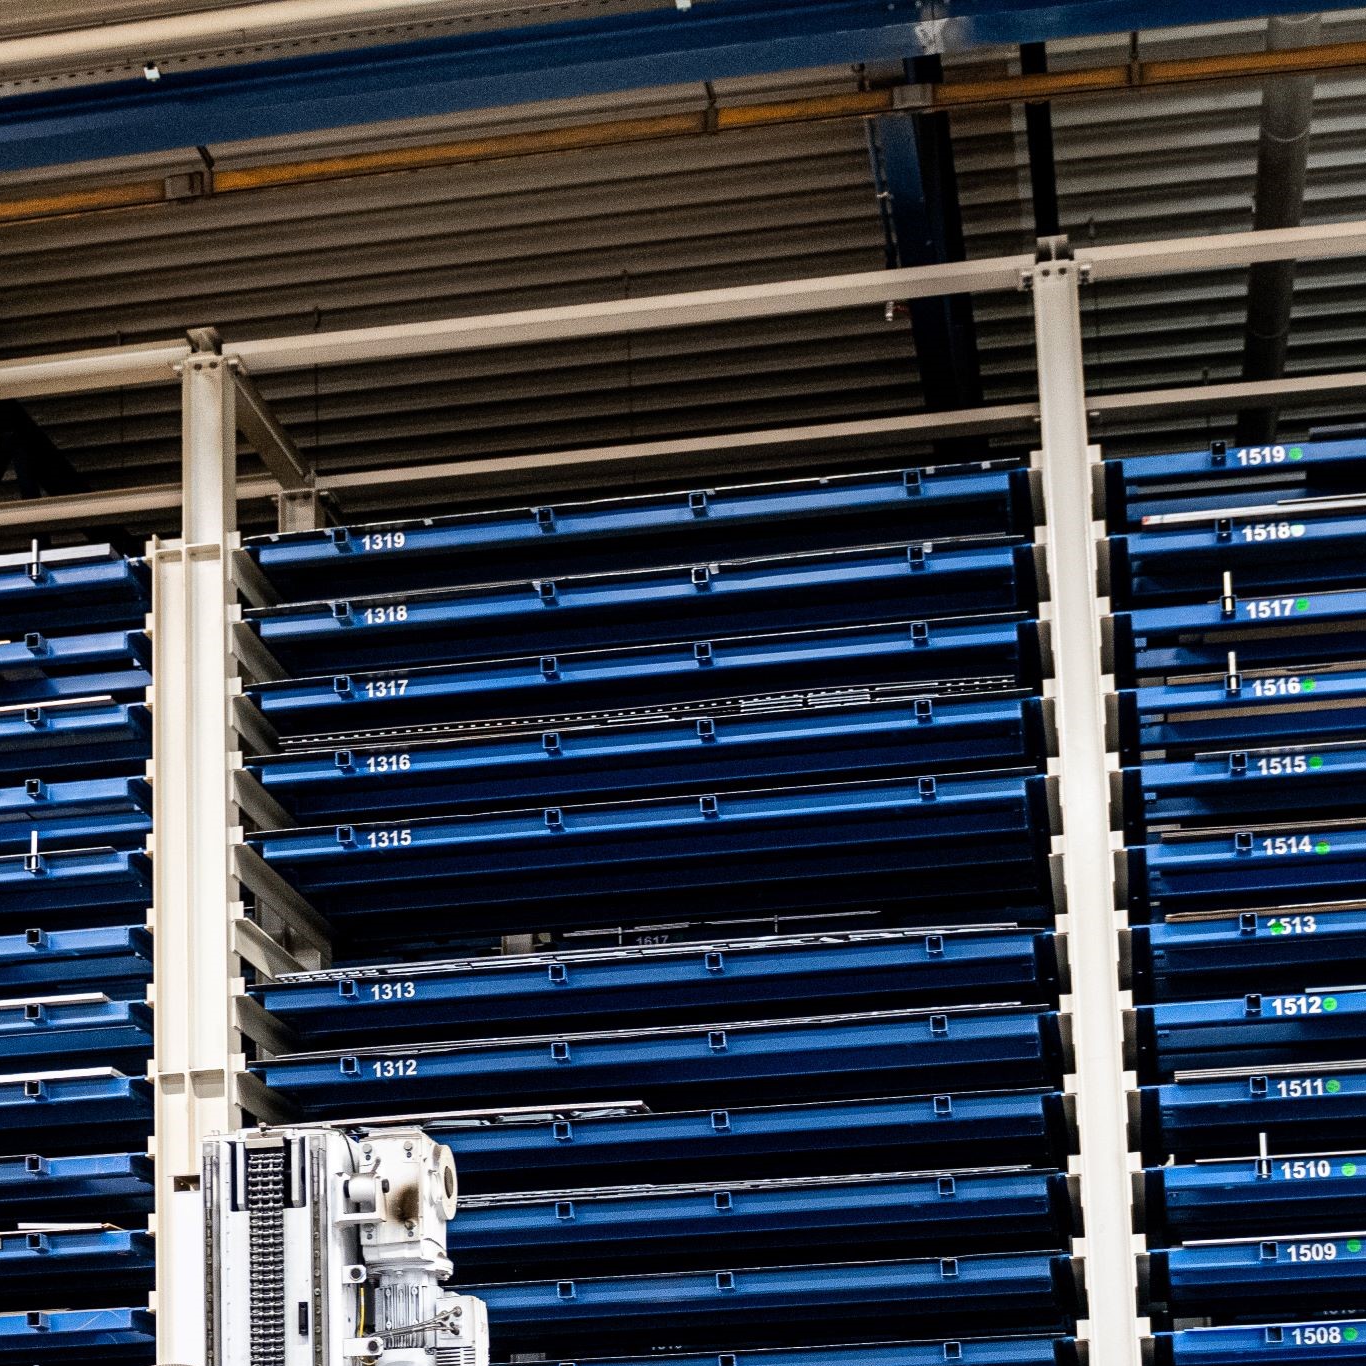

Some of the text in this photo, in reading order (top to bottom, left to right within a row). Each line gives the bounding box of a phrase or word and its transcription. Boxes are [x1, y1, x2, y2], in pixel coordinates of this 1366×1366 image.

[1237, 446, 1286, 466] 1519
[361, 532, 406, 550] 1319
[1242, 522, 1290, 542] 1518
[364, 605, 408, 624] 1318
[1246, 598, 1295, 619] 1517
[365, 679, 408, 698] 1317
[1252, 677, 1300, 697] 1516
[366, 754, 411, 773] 1316
[1257, 755, 1307, 775] 1515
[367, 829, 412, 848] 1315
[1262, 835, 1312, 855] 1514
[371, 982, 415, 1000] 1313
[1272, 996, 1322, 1016] 1512
[372, 1059, 418, 1078] 1312
[1277, 1078, 1324, 1098] 1511
[1281, 1160, 1331, 1179] 1510
[1286, 1242, 1337, 1262] 1509
[1291, 1326, 1341, 1345] 1508
